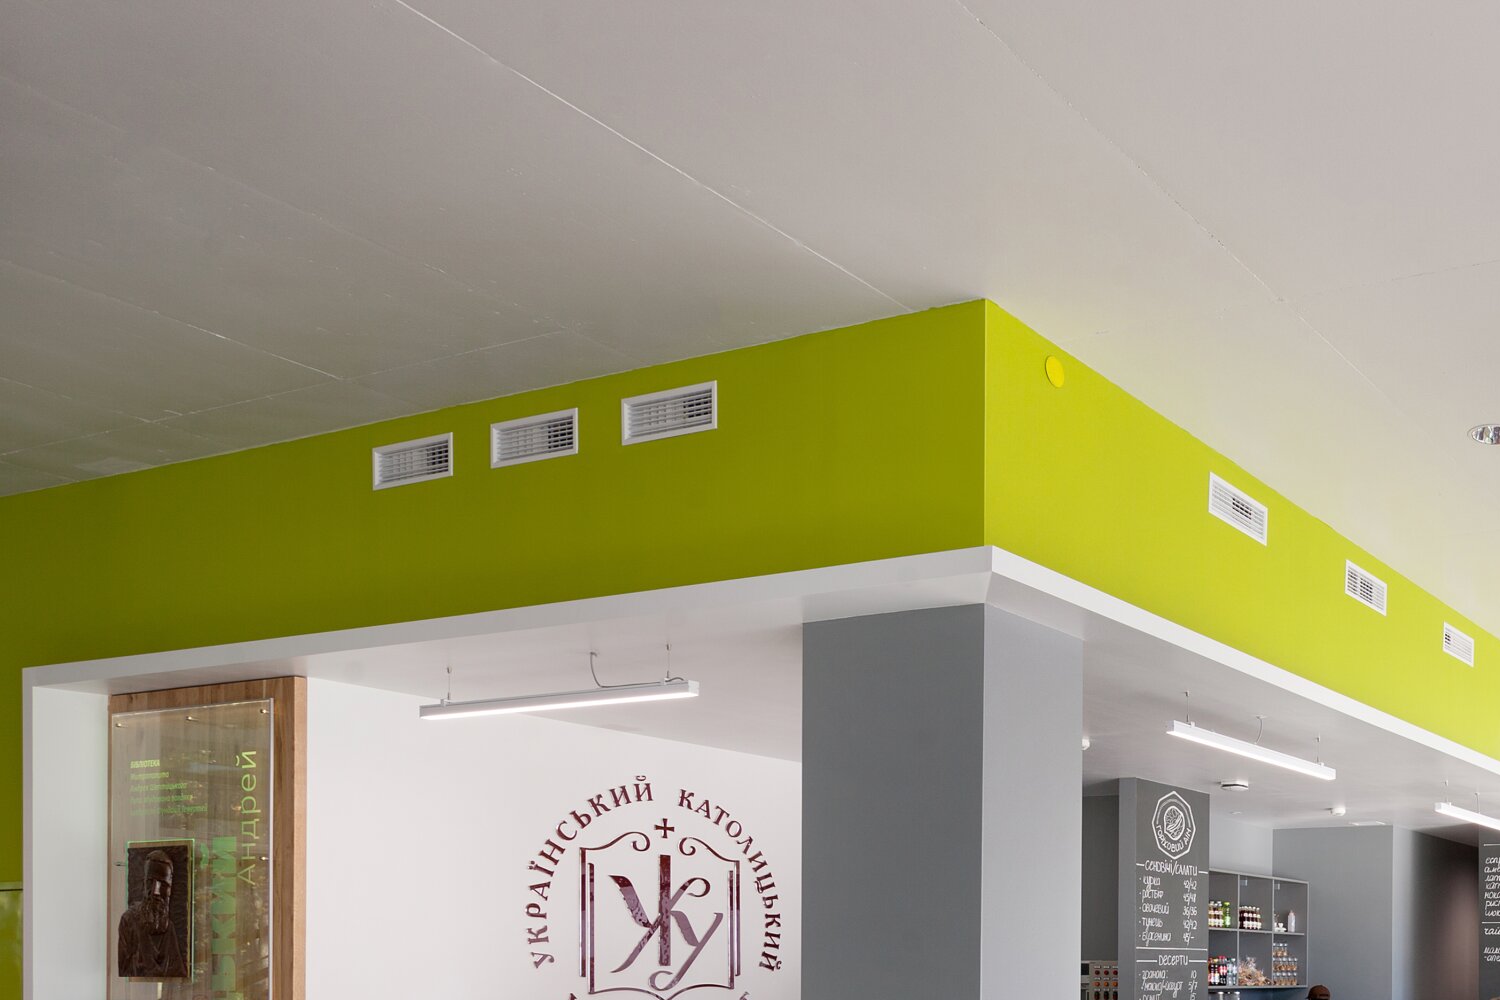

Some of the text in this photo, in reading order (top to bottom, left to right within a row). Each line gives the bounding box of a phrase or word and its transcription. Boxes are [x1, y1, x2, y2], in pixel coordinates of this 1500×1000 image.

[235, 750, 262, 886] Андрей
[525, 775, 782, 972] УКРАЇНСЬКИЙ КАТОЛИЦЬКИЙ
